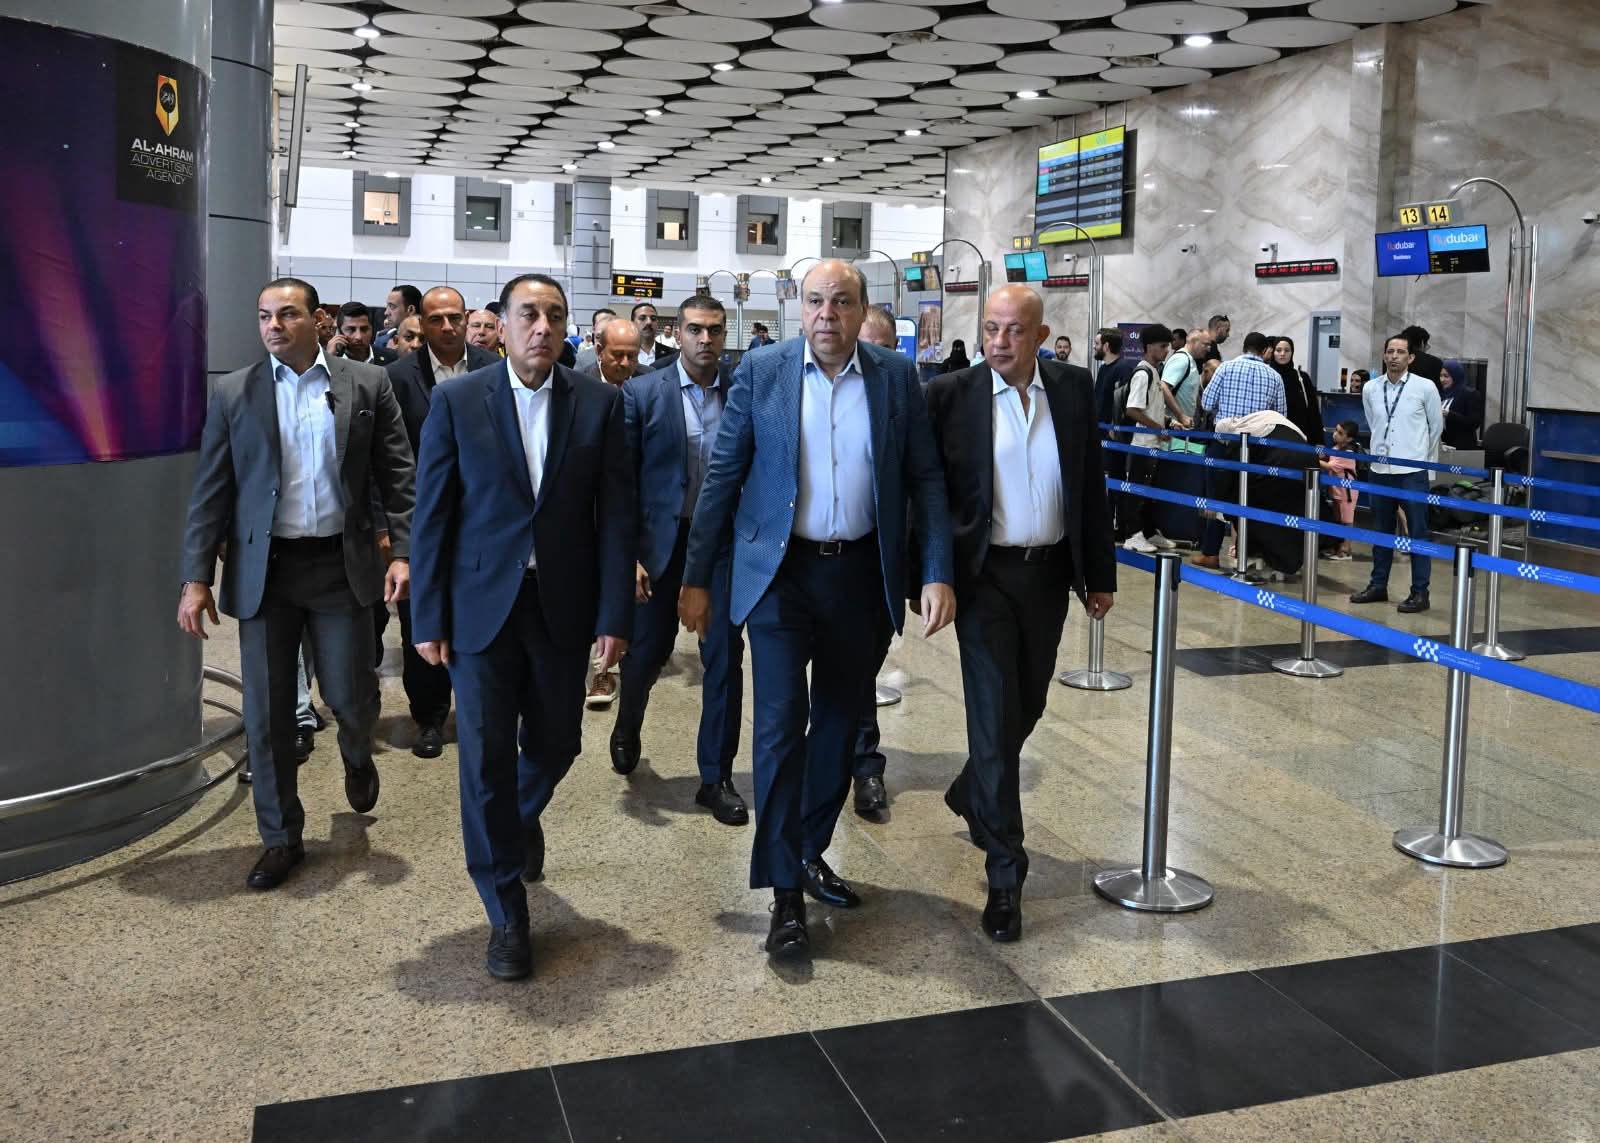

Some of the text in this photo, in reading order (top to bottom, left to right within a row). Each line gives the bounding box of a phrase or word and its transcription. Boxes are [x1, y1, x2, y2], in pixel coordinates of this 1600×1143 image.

[132, 153, 193, 176] ADVERTISING
[146, 169, 186, 185] AGENCY
[1403, 206, 1447, 223] 13 14
[647, 289, 653, 297] 3
